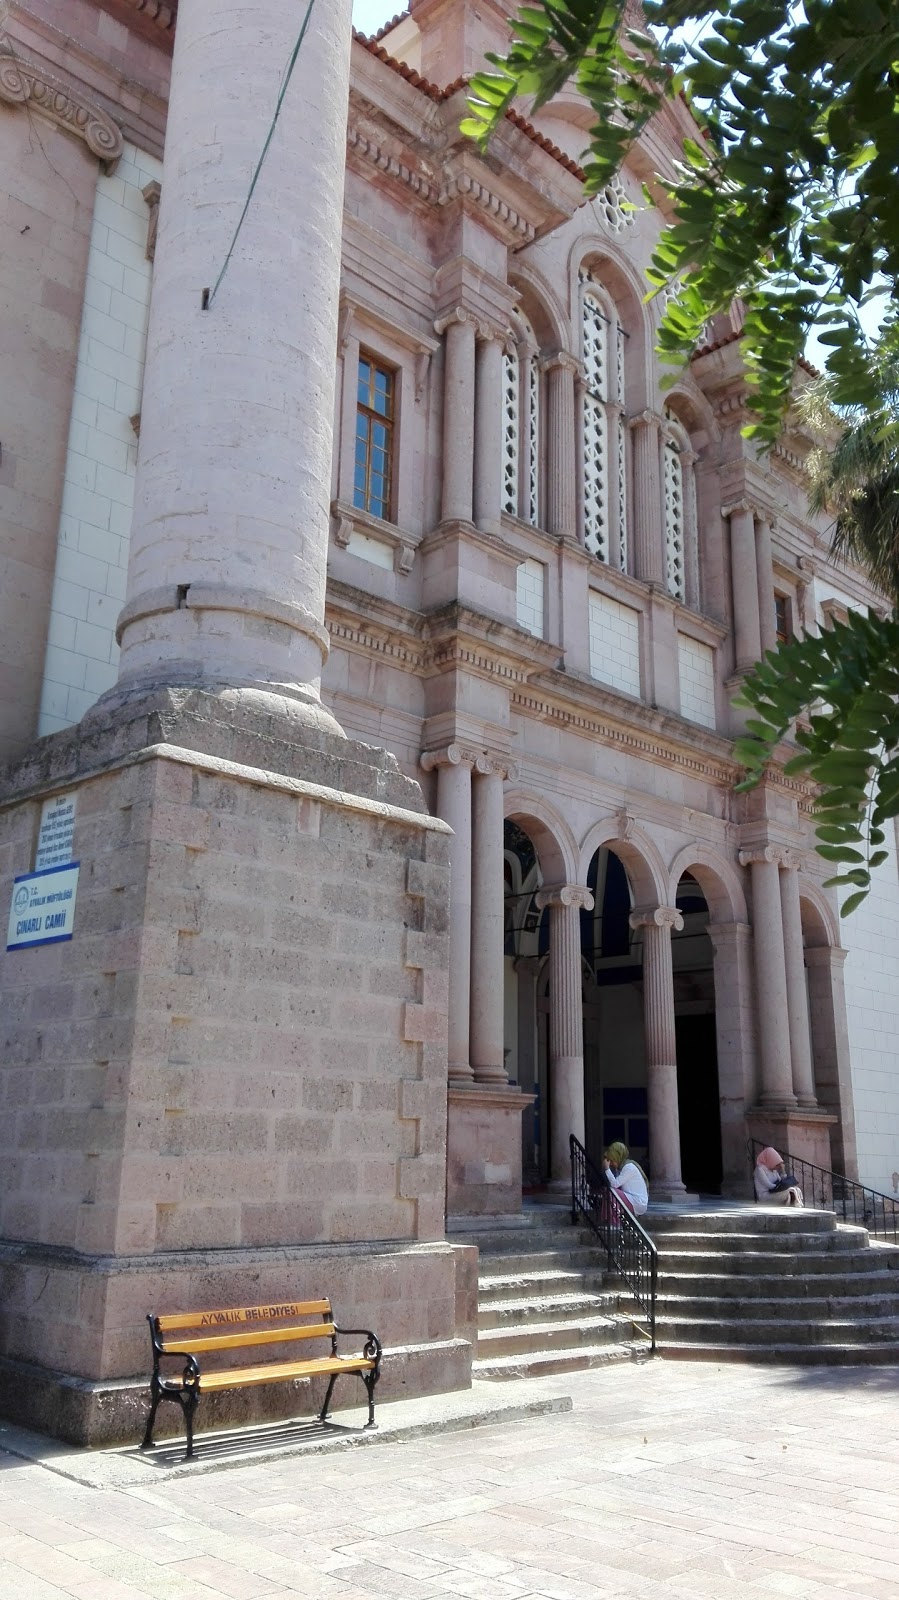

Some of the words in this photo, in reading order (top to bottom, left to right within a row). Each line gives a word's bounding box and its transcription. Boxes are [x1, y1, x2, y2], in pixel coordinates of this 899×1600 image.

[29, 896, 46, 908] AYVALIK
[17, 917, 42, 937] ÇINARLI
[201, 1311, 240, 1325] AYVALIK
